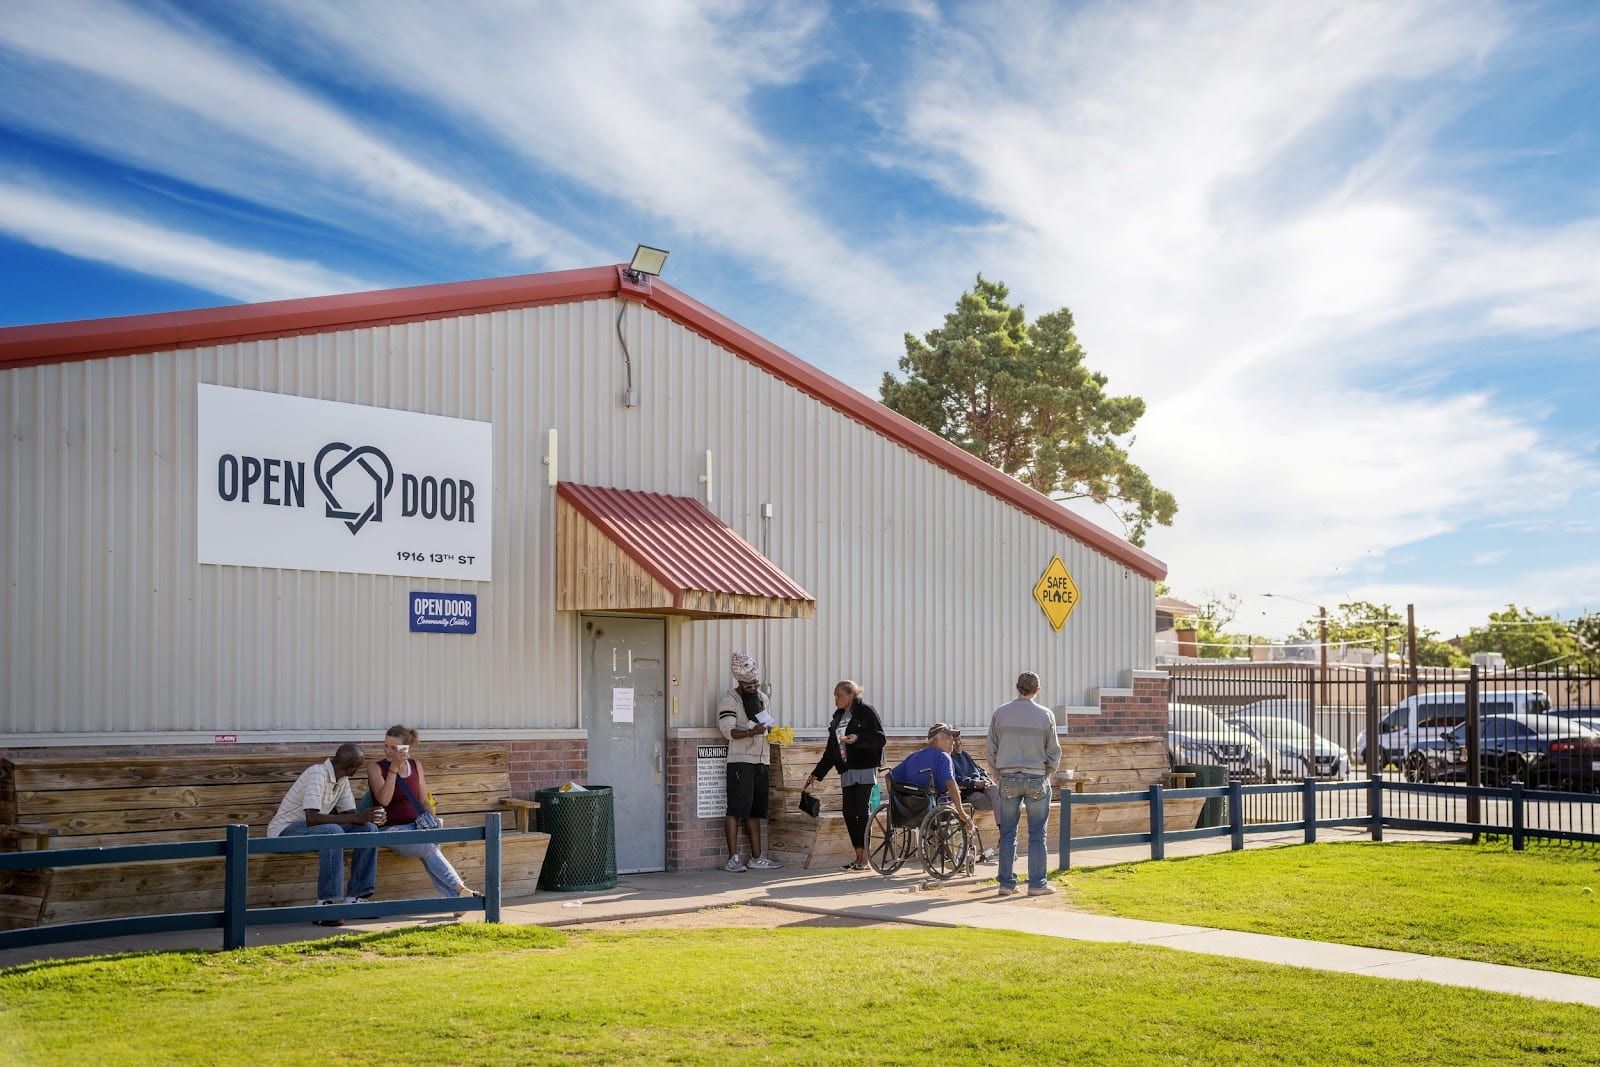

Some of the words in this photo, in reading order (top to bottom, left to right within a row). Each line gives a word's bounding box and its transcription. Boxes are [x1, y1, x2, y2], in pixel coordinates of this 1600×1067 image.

[218, 453, 305, 508] OPEN
[401, 473, 475, 523] DOOR
[396, 551, 425, 562] 1916
[430, 553, 455, 563] 13TH
[458, 555, 476, 565] ST
[1047, 576, 1067, 589] SAFE
[414, 598, 443, 616] OPEN
[444, 599, 472, 617] DOOR
[416, 616, 449, 627] Community
[449, 617, 470, 627] Center
[698, 747, 727, 757] WARNING
